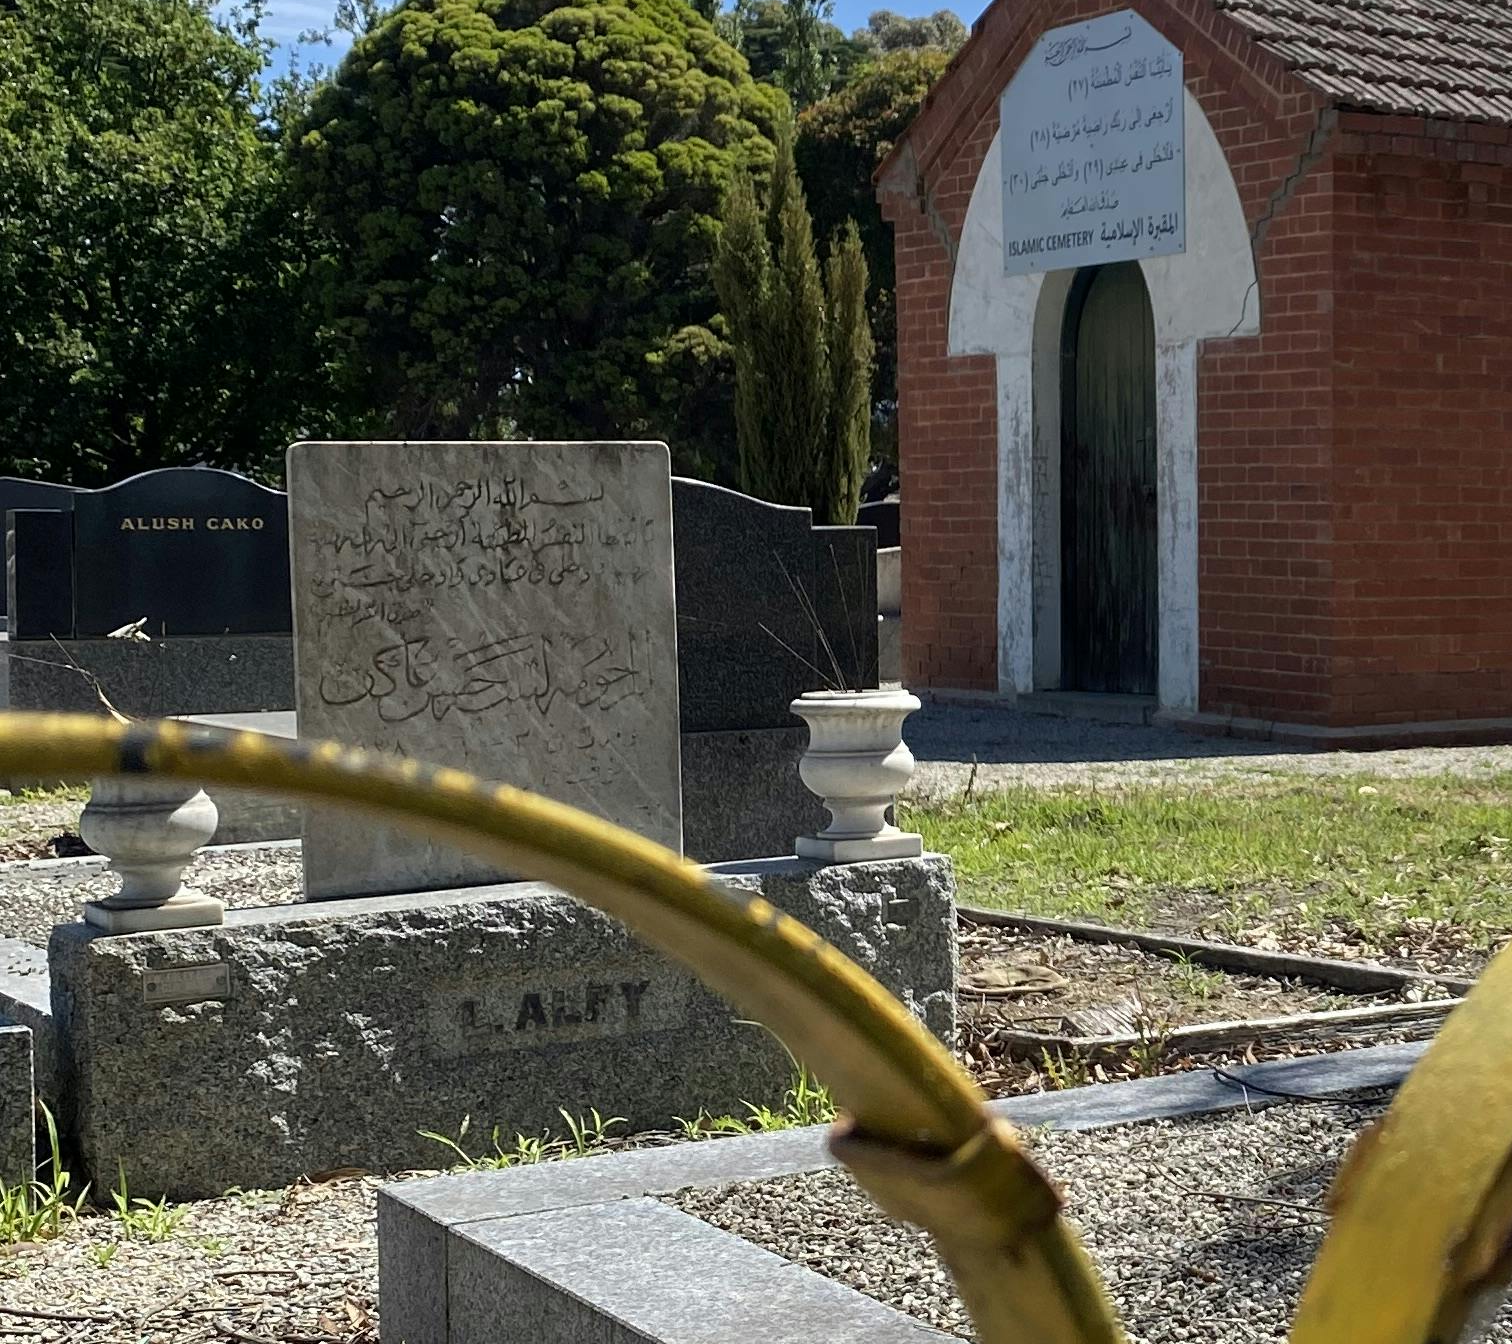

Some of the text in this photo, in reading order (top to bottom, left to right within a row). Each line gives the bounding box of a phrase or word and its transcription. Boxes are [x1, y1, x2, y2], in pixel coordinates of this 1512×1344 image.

[1148, 211, 1178, 241] المقبرة
[1008, 228, 1095, 257] ISLAMIC CEMETERY
[120, 517, 265, 531] ALUSH CAKO
